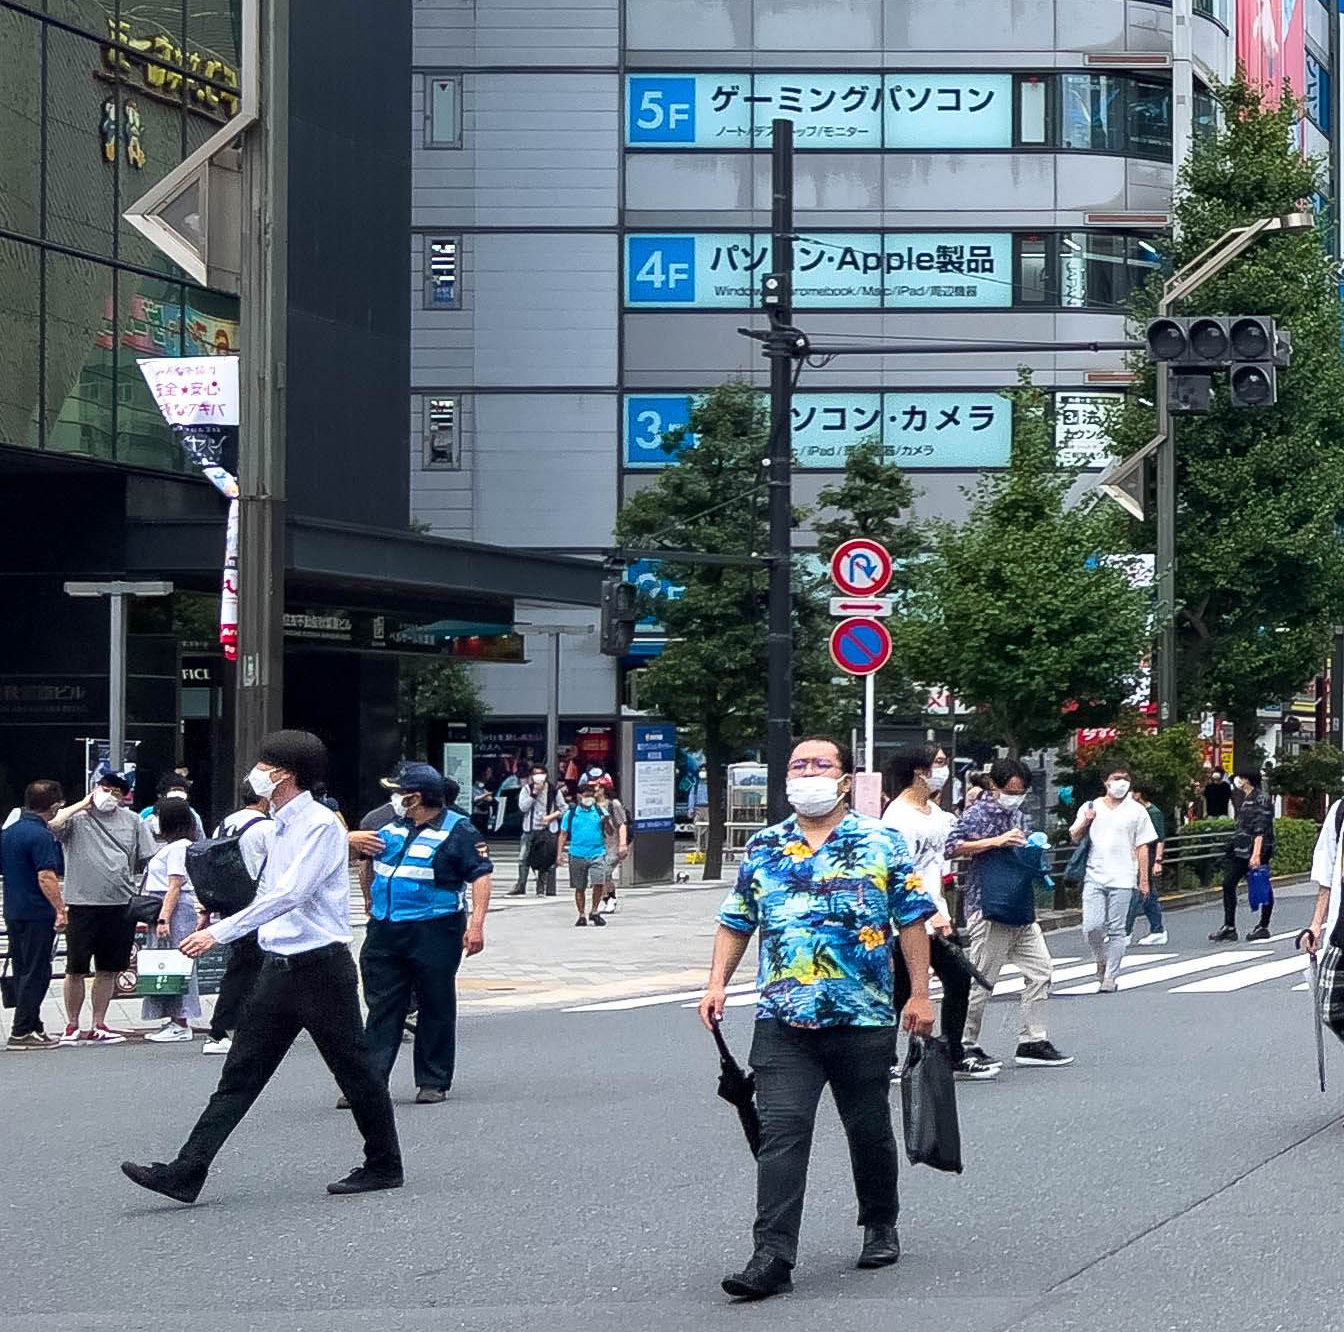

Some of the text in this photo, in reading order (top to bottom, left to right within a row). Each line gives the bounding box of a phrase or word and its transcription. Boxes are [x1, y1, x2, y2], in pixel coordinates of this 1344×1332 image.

[635, 89, 692, 131] 5F
[711, 85, 995, 115] ゲーミングパソコン
[636, 249, 689, 290] 4F
[710, 244, 995, 275] パソン・Apple製品
